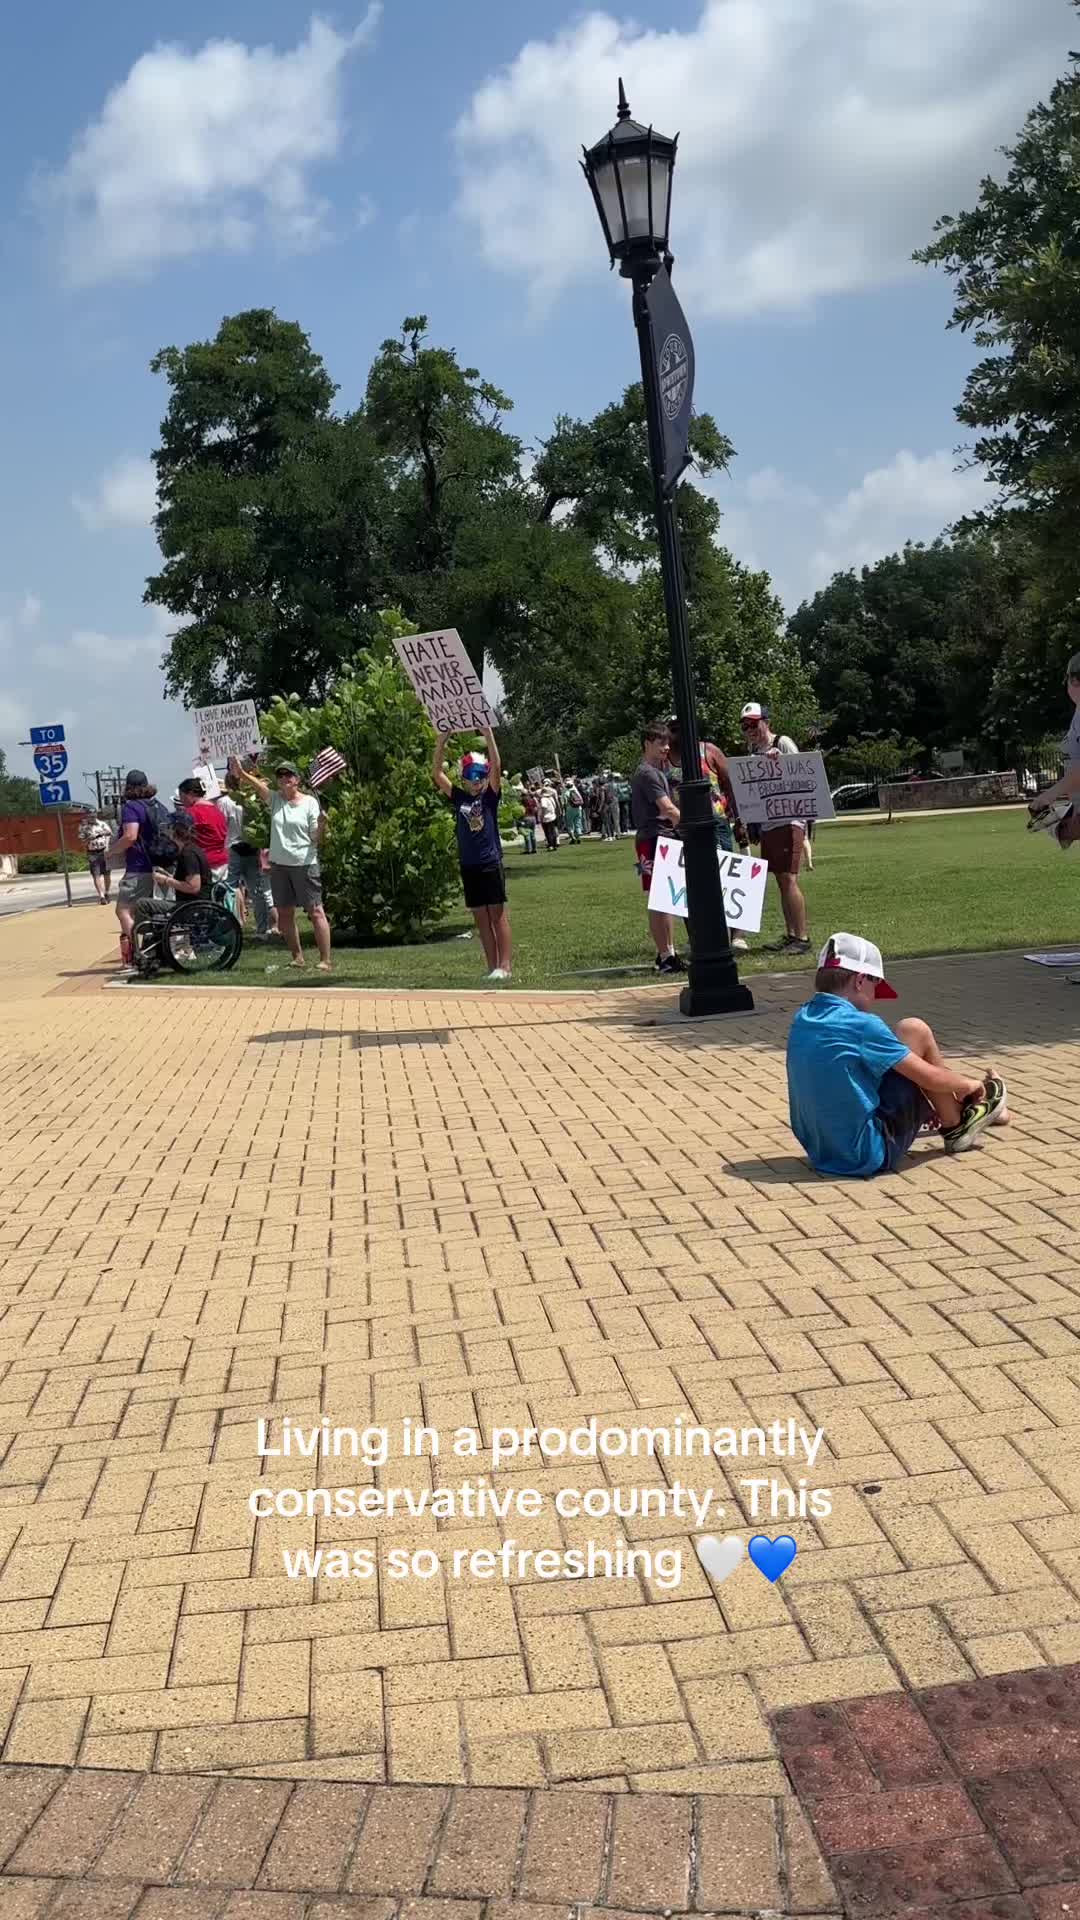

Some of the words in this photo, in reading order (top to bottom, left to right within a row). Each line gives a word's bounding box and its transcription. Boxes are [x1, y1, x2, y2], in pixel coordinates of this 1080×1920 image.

[402, 636, 456, 665] HATE
[411, 660, 463, 686] NEVER
[420, 675, 482, 704] MADE
[200, 708, 218, 723] LOVE
[220, 703, 249, 718] AMERICA
[436, 710, 491, 733] GREAT
[40, 729, 56, 741] TO
[200, 722, 215, 736] AND
[216, 715, 256, 733] DEMOCRACY
[39, 754, 65, 774] 35
[736, 760, 783, 781] JESUS
[786, 759, 815, 776] WAS
[766, 798, 818, 817] REFUGEE
[678, 846, 743, 878] LVE
[667, 875, 746, 920] WS
